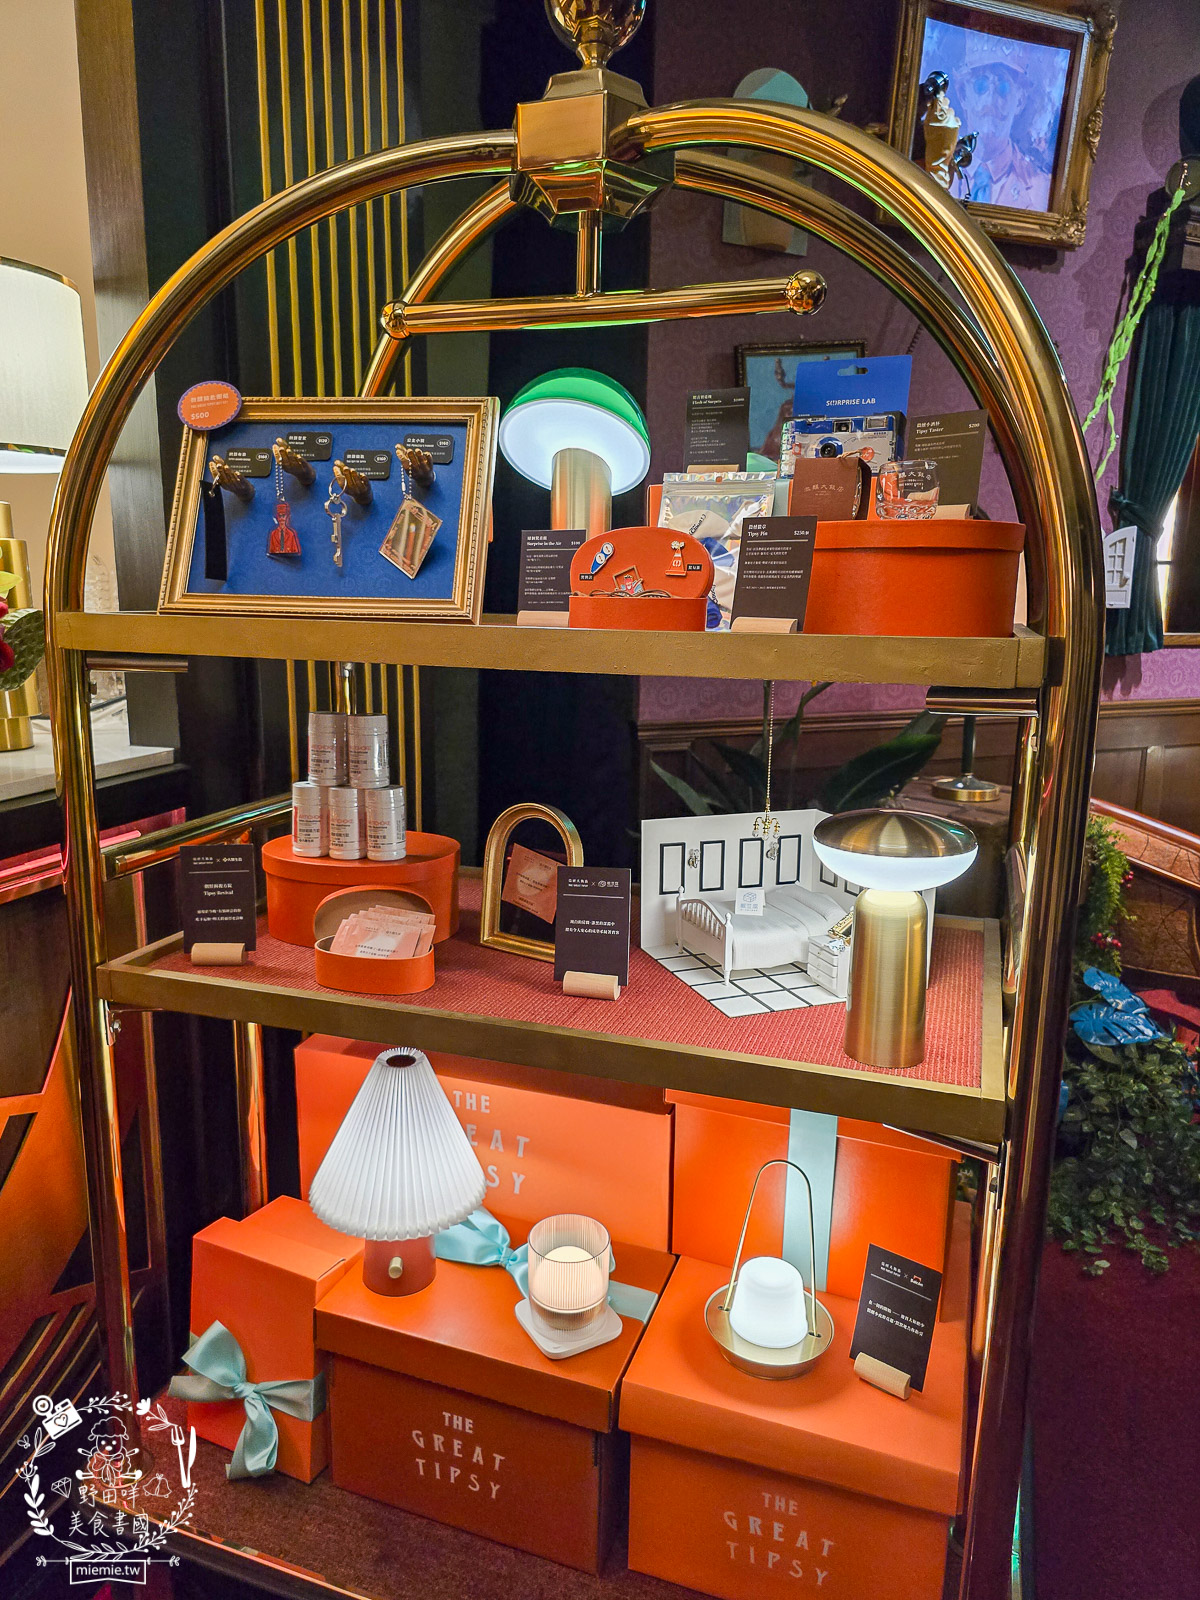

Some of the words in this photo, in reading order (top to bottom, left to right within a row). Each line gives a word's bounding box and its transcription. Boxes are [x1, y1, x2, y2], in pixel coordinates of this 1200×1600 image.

[191, 412, 210, 420] $500
[453, 1090, 490, 1114] THE
[466, 1124, 530, 1159] EAT
[442, 1411, 474, 1434] THE
[412, 1430, 506, 1472] GREAT
[415, 1458, 501, 1500] TIPSY
[762, 1492, 798, 1516] THE
[723, 1511, 835, 1557] GREAT
[726, 1541, 829, 1586] TIPSY
